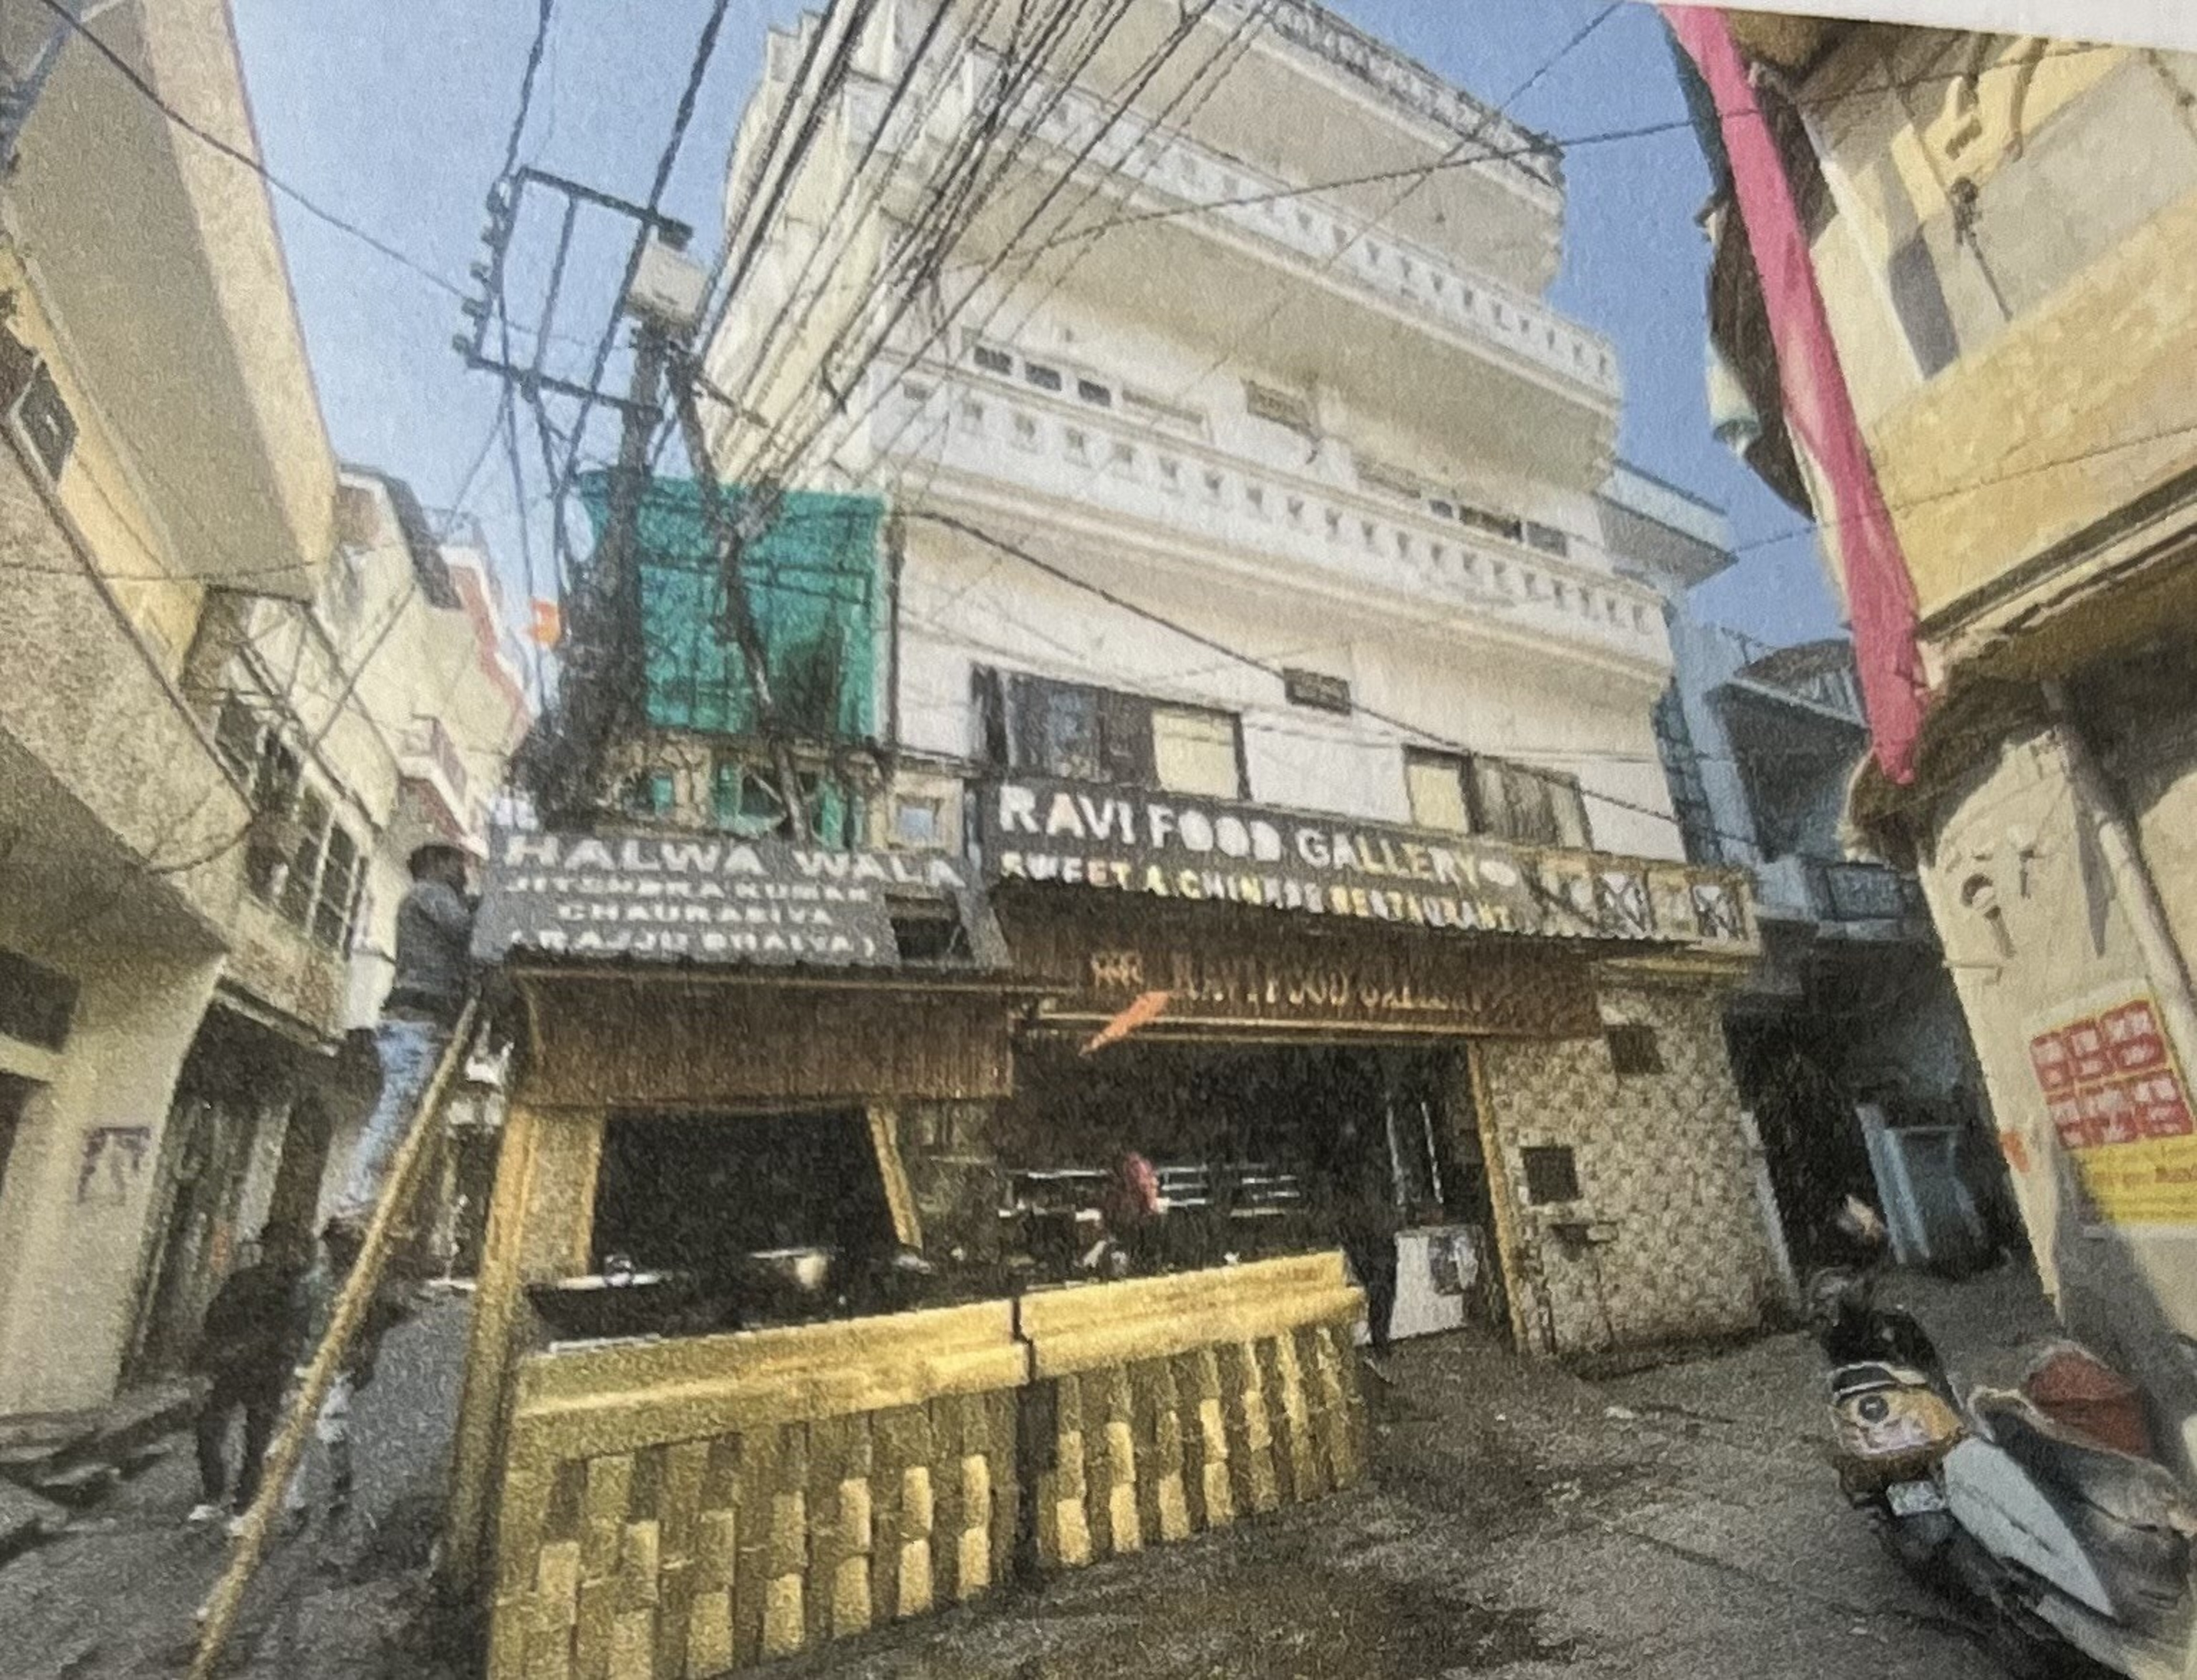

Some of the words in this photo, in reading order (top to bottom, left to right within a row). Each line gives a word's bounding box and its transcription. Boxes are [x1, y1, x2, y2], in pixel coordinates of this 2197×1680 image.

[504, 835, 768, 876] HALWA
[792, 849, 966, 887] WALA
[1000, 786, 1136, 845] RAVI
[1147, 804, 1281, 860] FOOD
[1296, 828, 1479, 891] GALLERY
[1001, 851, 1131, 891] SWEET
